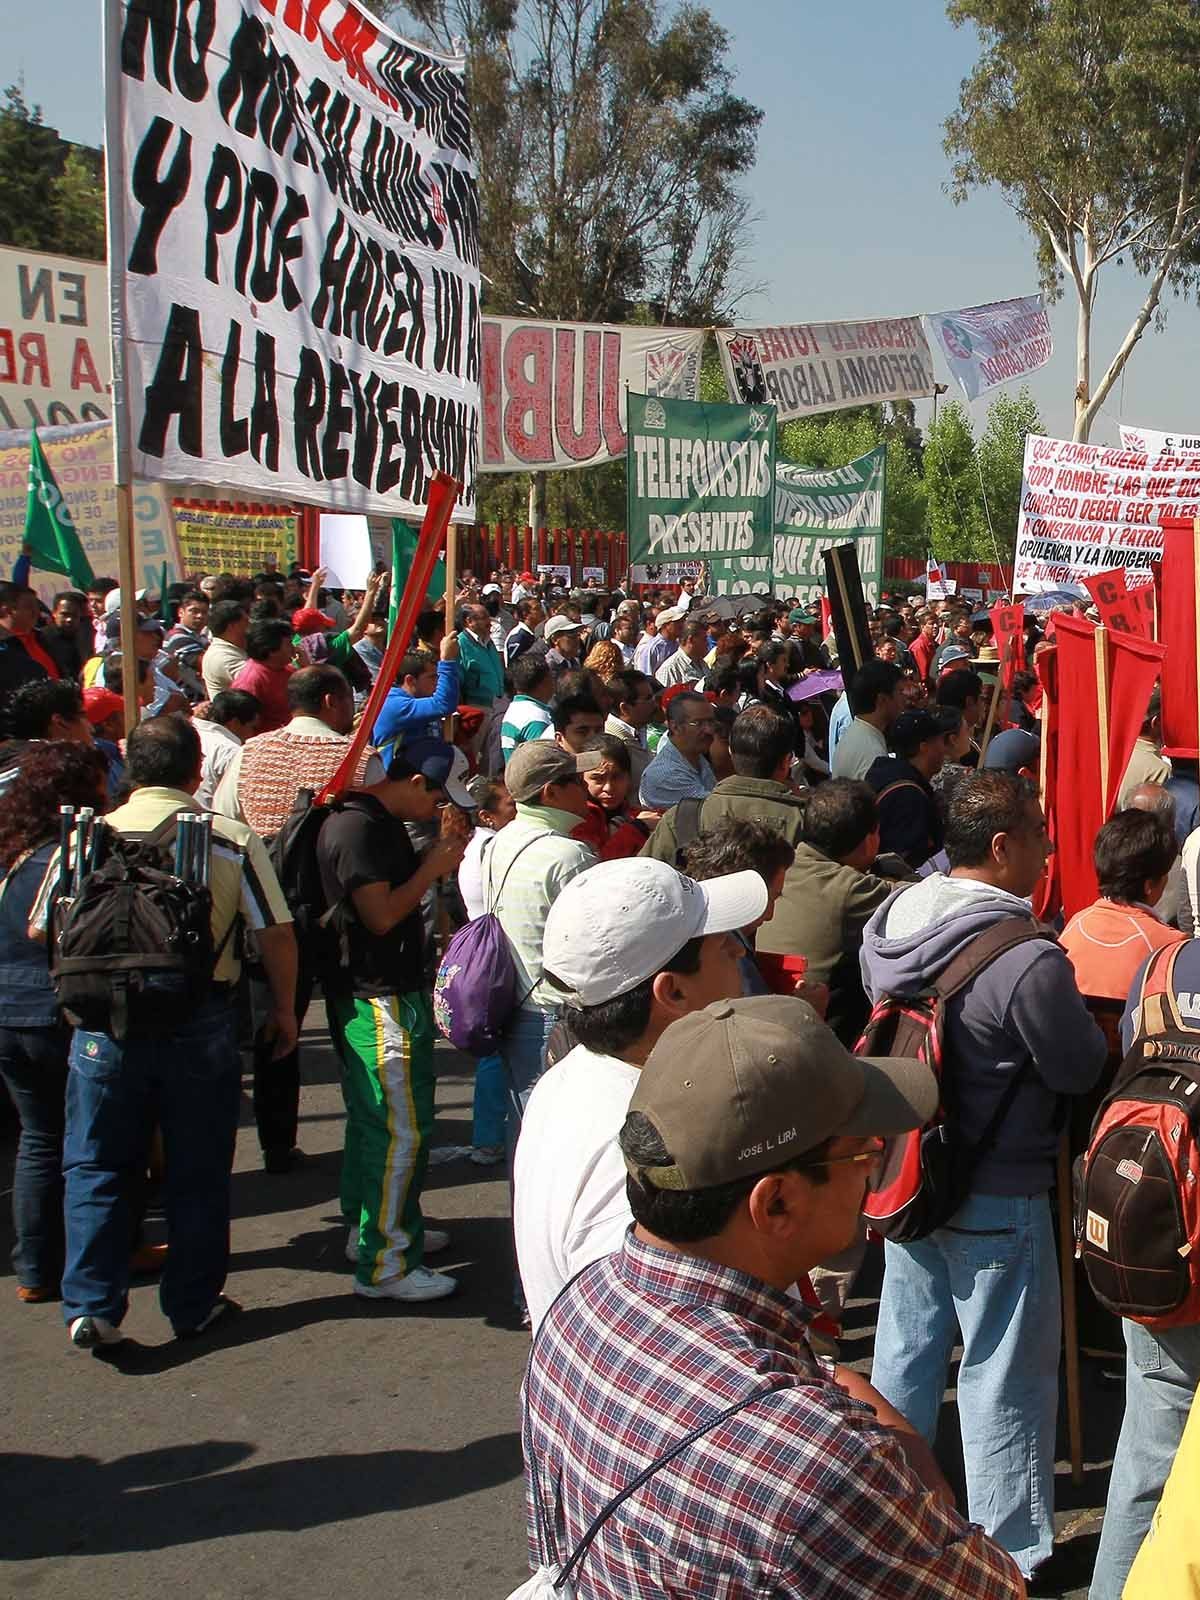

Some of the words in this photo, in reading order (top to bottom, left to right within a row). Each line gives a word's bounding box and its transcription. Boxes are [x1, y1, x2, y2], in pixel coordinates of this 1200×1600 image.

[127, 116, 193, 275] Y
[311, 207, 424, 370] HACER
[137, 303, 202, 457] A
[220, 318, 279, 472] LA
[634, 436, 771, 498] TELEFONISTAS
[1058, 442, 1098, 466] COMO
[1101, 449, 1148, 471] BUENA
[836, 465, 864, 485] LA
[1028, 464, 1053, 487] TODO
[1113, 475, 1142, 497] LAS
[1145, 477, 1176, 500] QUE
[1023, 491, 1079, 519] CONGRESO
[1079, 498, 1122, 522] DEBEN
[1125, 502, 1153, 524] SER
[648, 510, 754, 555] PRESENTES
[1032, 519, 1102, 545] CONSTANCIA
[1108, 527, 1118, 545] Y
[773, 534, 812, 578] QUE
[1018, 540, 1071, 564] OPULENCIA
[1083, 548, 1099, 566] LA
[1016, 562, 1032, 578] SE
[738, 1143, 763, 1160] JOSE
[778, 1127, 798, 1145] LIRA
